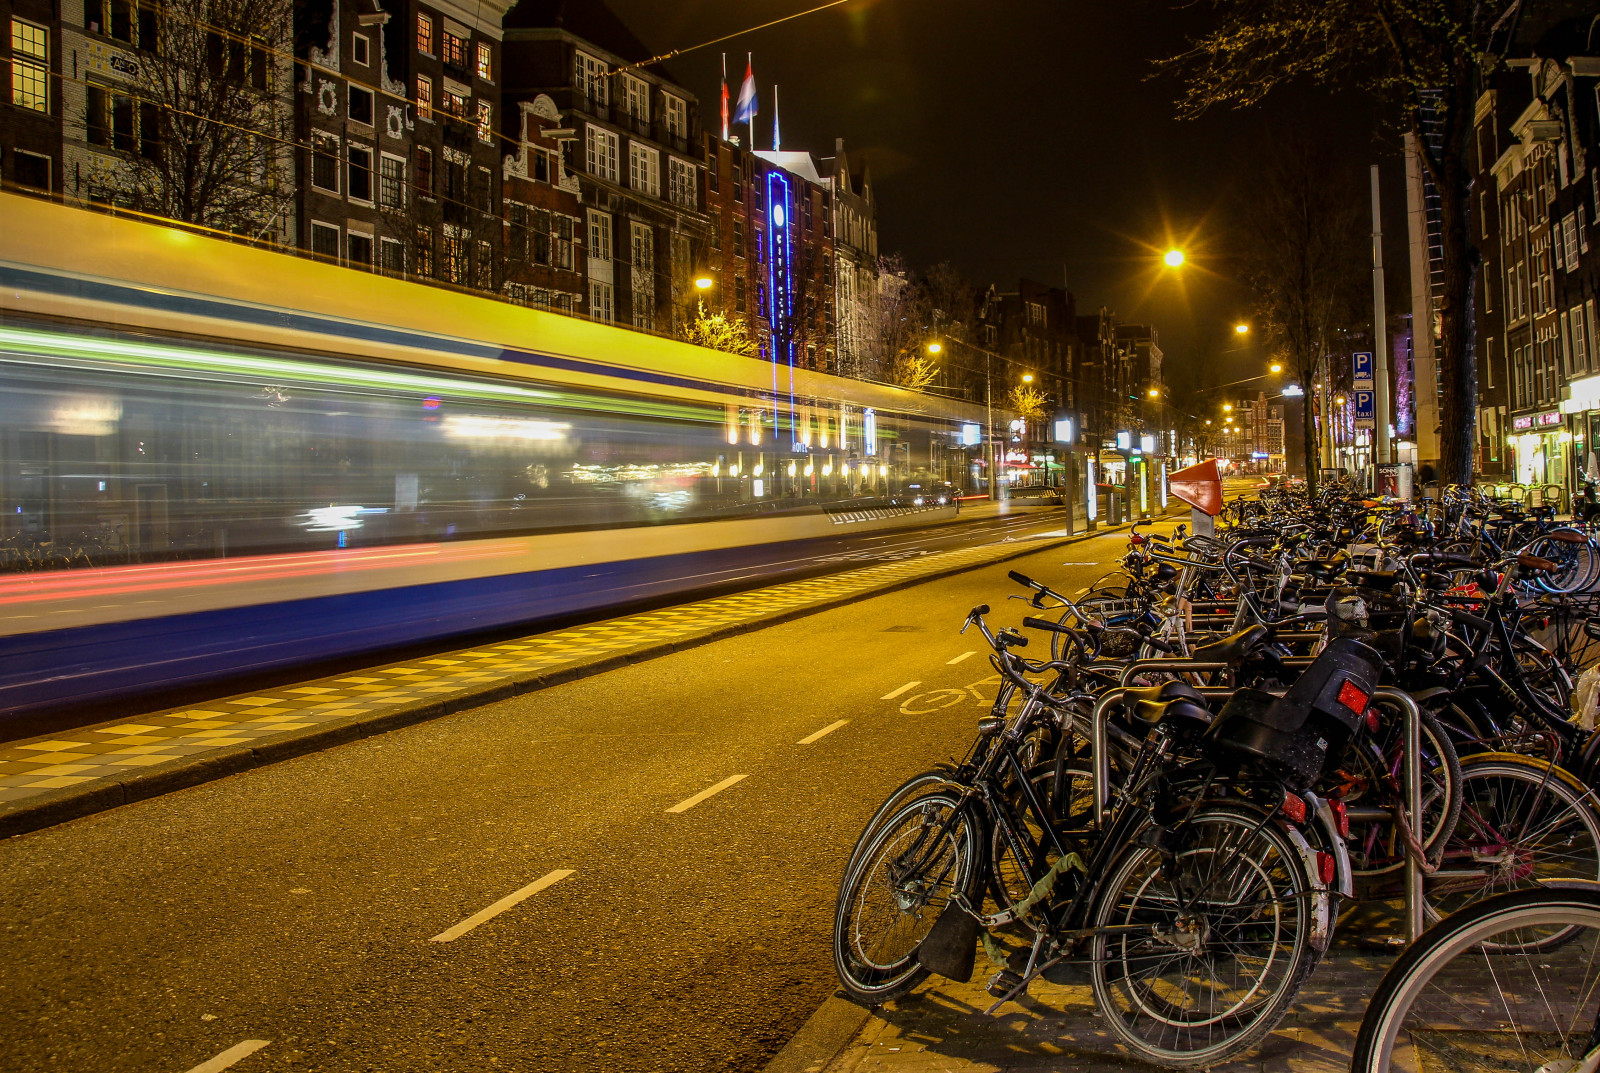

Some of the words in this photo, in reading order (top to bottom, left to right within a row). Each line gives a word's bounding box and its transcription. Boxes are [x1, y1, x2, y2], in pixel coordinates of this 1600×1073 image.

[1357, 354, 1368, 369] P
[1358, 393, 1370, 407] P
[791, 440, 808, 453] HOTEL
